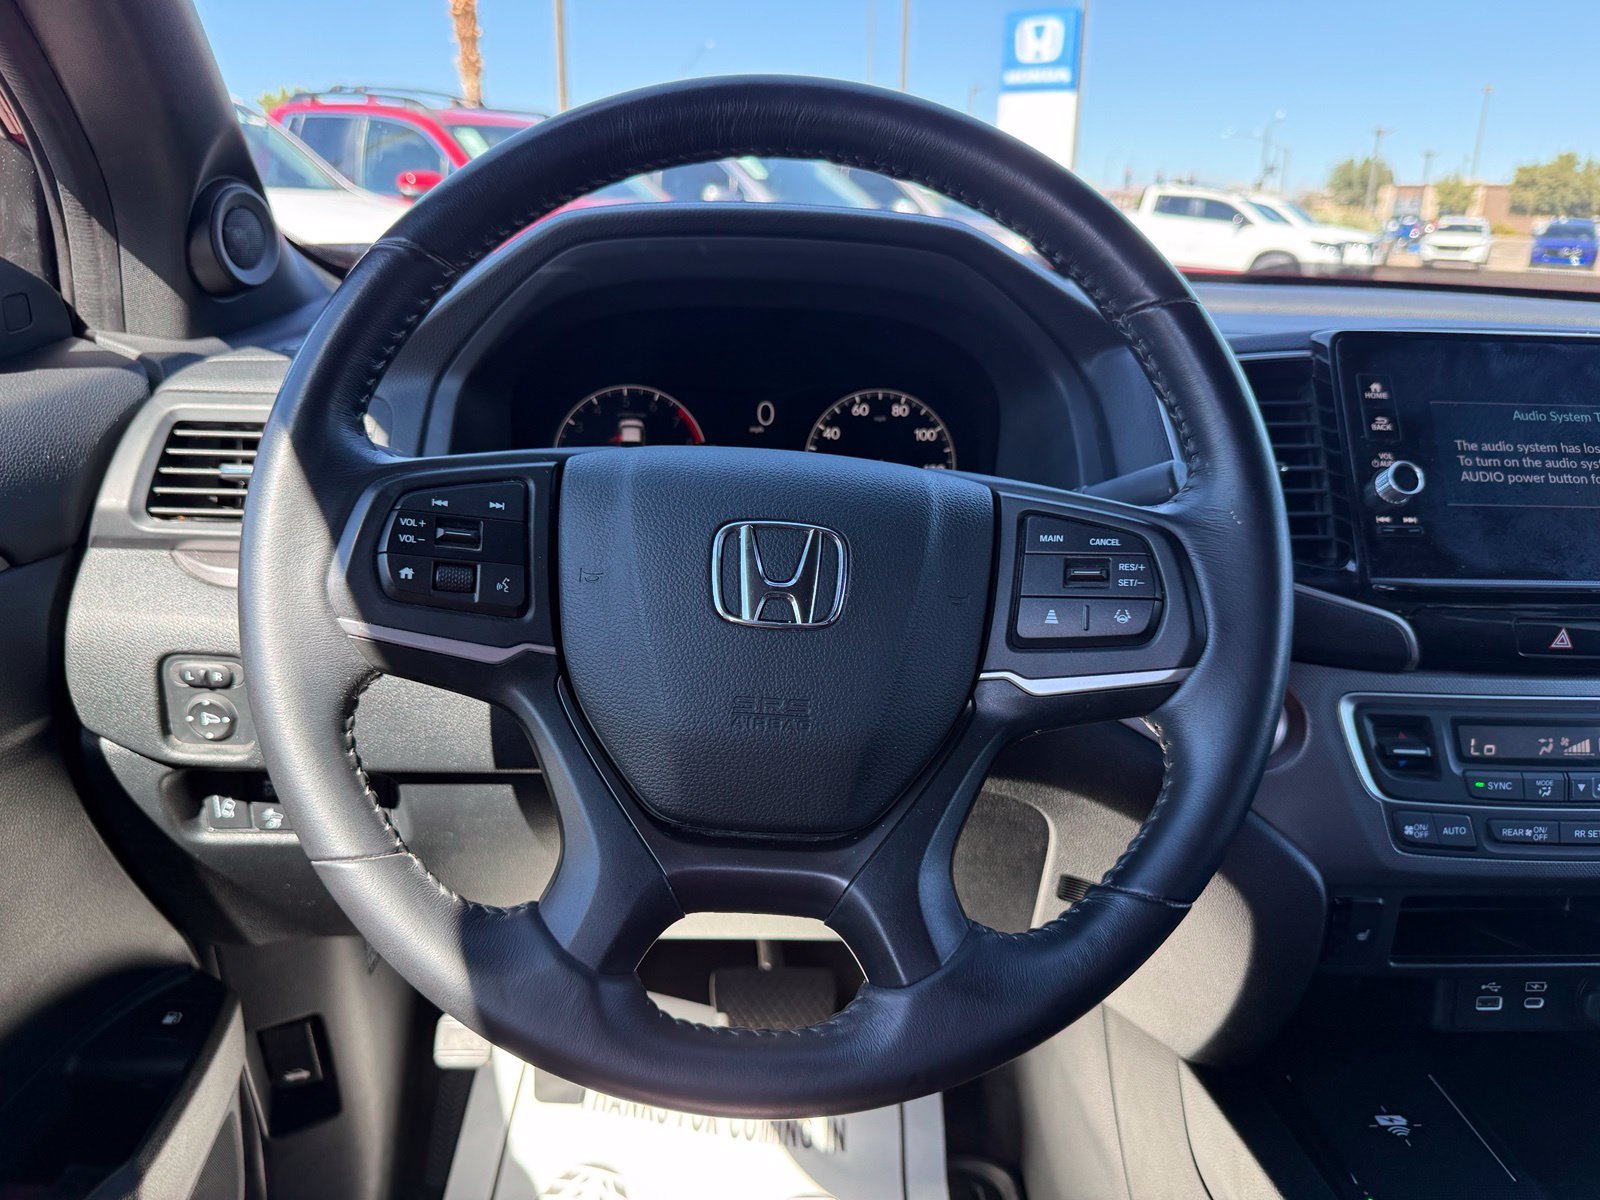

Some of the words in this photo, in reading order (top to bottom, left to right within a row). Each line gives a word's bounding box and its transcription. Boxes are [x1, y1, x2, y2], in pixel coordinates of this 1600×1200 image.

[1364, 392, 1389, 400] HOME
[756, 400, 775, 426] 0
[851, 403, 870, 417] 60
[891, 404, 910, 417] 80
[1512, 410, 1547, 421] Audio
[1549, 411, 1592, 424] System
[822, 426, 841, 440] 40
[914, 428, 938, 442] 100
[1454, 439, 1478, 452] The
[1481, 441, 1514, 452] audio
[1517, 442, 1558, 454] system
[1560, 442, 1581, 453] has
[1378, 452, 1394, 460] VOL
[1457, 455, 1473, 467] To
[1475, 456, 1501, 467] turn
[1503, 458, 1520, 468] on
[1522, 457, 1542, 468] the
[1545, 458, 1578, 469] audio
[1580, 459, 1600, 471] sys
[1460, 471, 1504, 483] AUDIO
[1507, 474, 1545, 485] power
[1548, 473, 1588, 484] button
[1039, 534, 1064, 543] MAIN
[1089, 538, 1122, 546] CANCEL
[1118, 563, 1146, 572] RES/+
[184, 670, 194, 681] L
[213, 672, 223, 682] R
[732, 695, 811, 717] SRS
[1487, 782, 1513, 790] SYNC
[1413, 831, 1429, 839] OFF
[1442, 826, 1467, 836] AUTO
[1502, 828, 1524, 837] REAR
[1574, 830, 1586, 838] RR
[1588, 830, 1600, 838] SE
